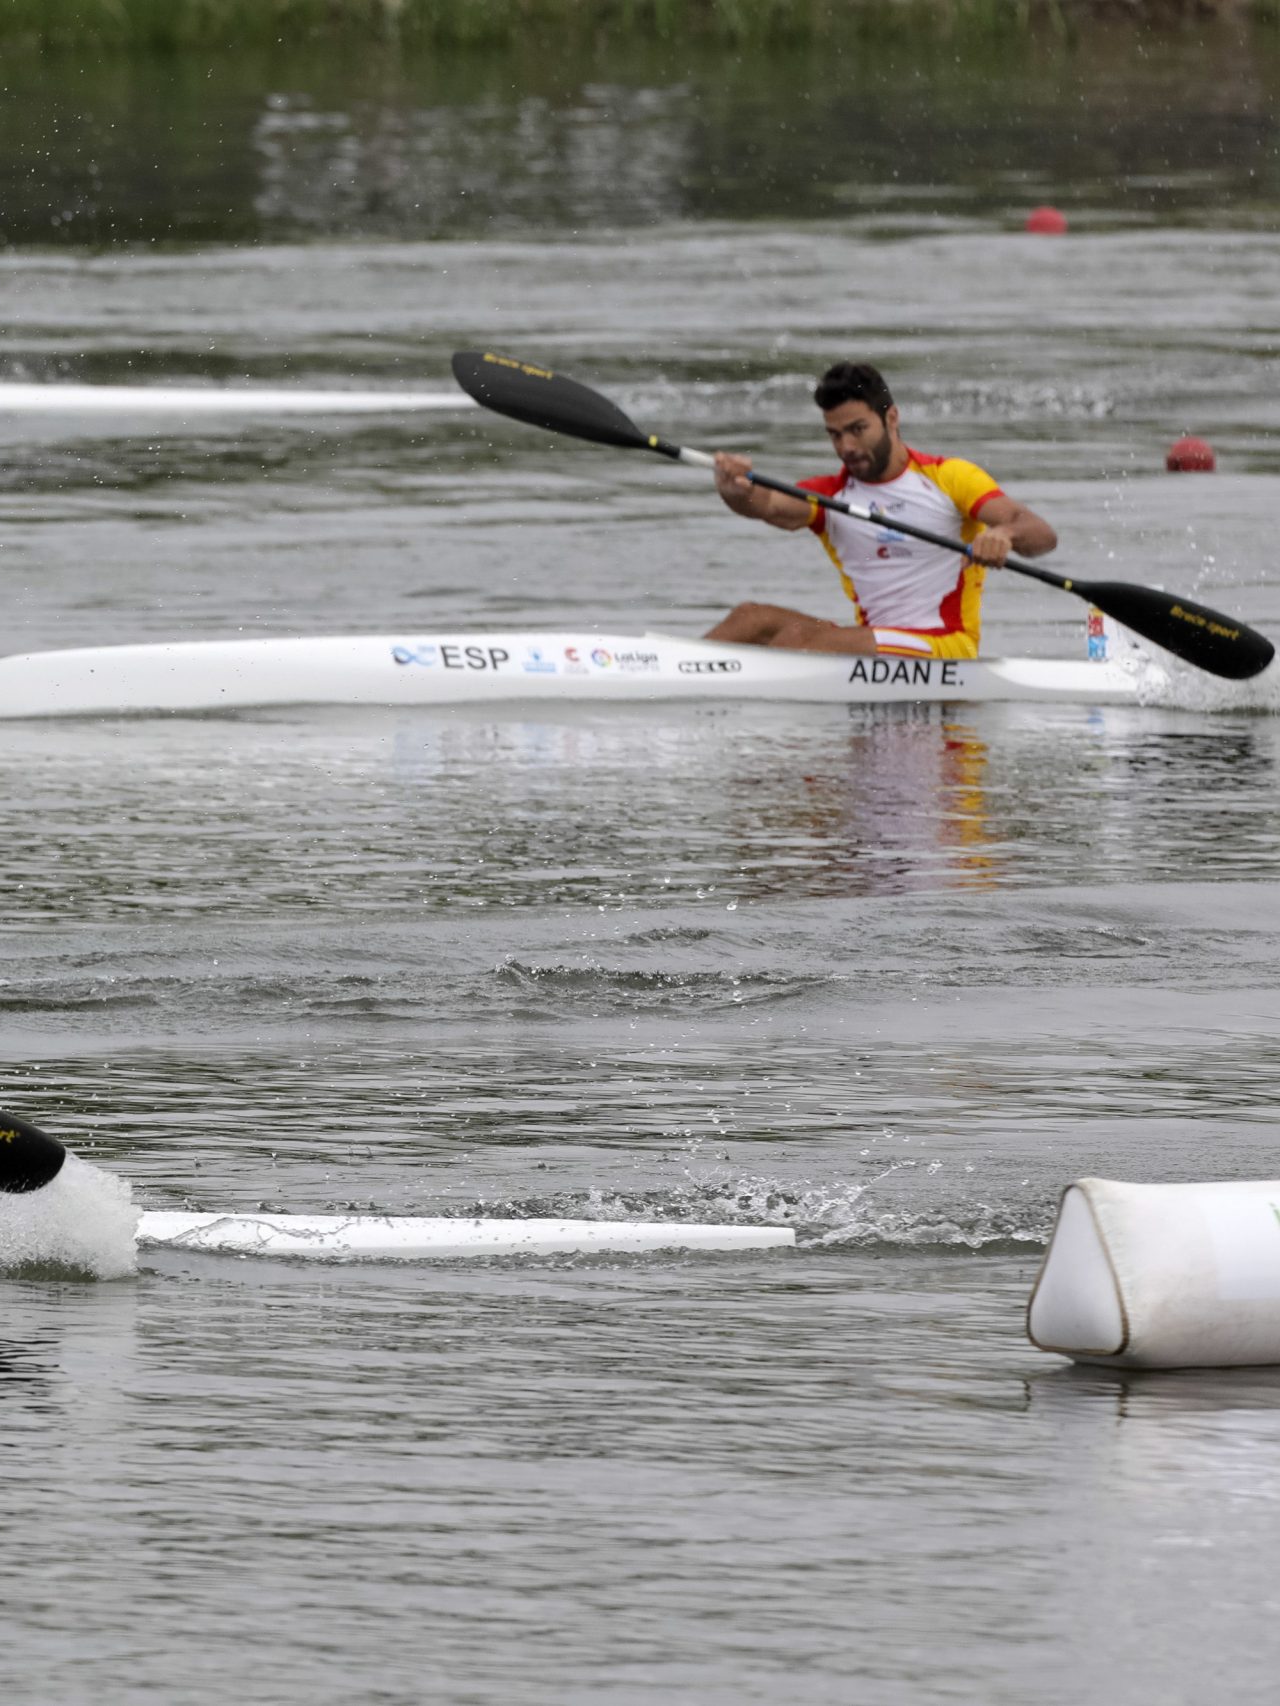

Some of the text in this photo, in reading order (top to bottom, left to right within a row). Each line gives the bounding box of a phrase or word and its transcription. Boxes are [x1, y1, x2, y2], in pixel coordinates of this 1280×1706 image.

[440, 645, 509, 670] ESP
[849, 659, 964, 686] ADAN E.
